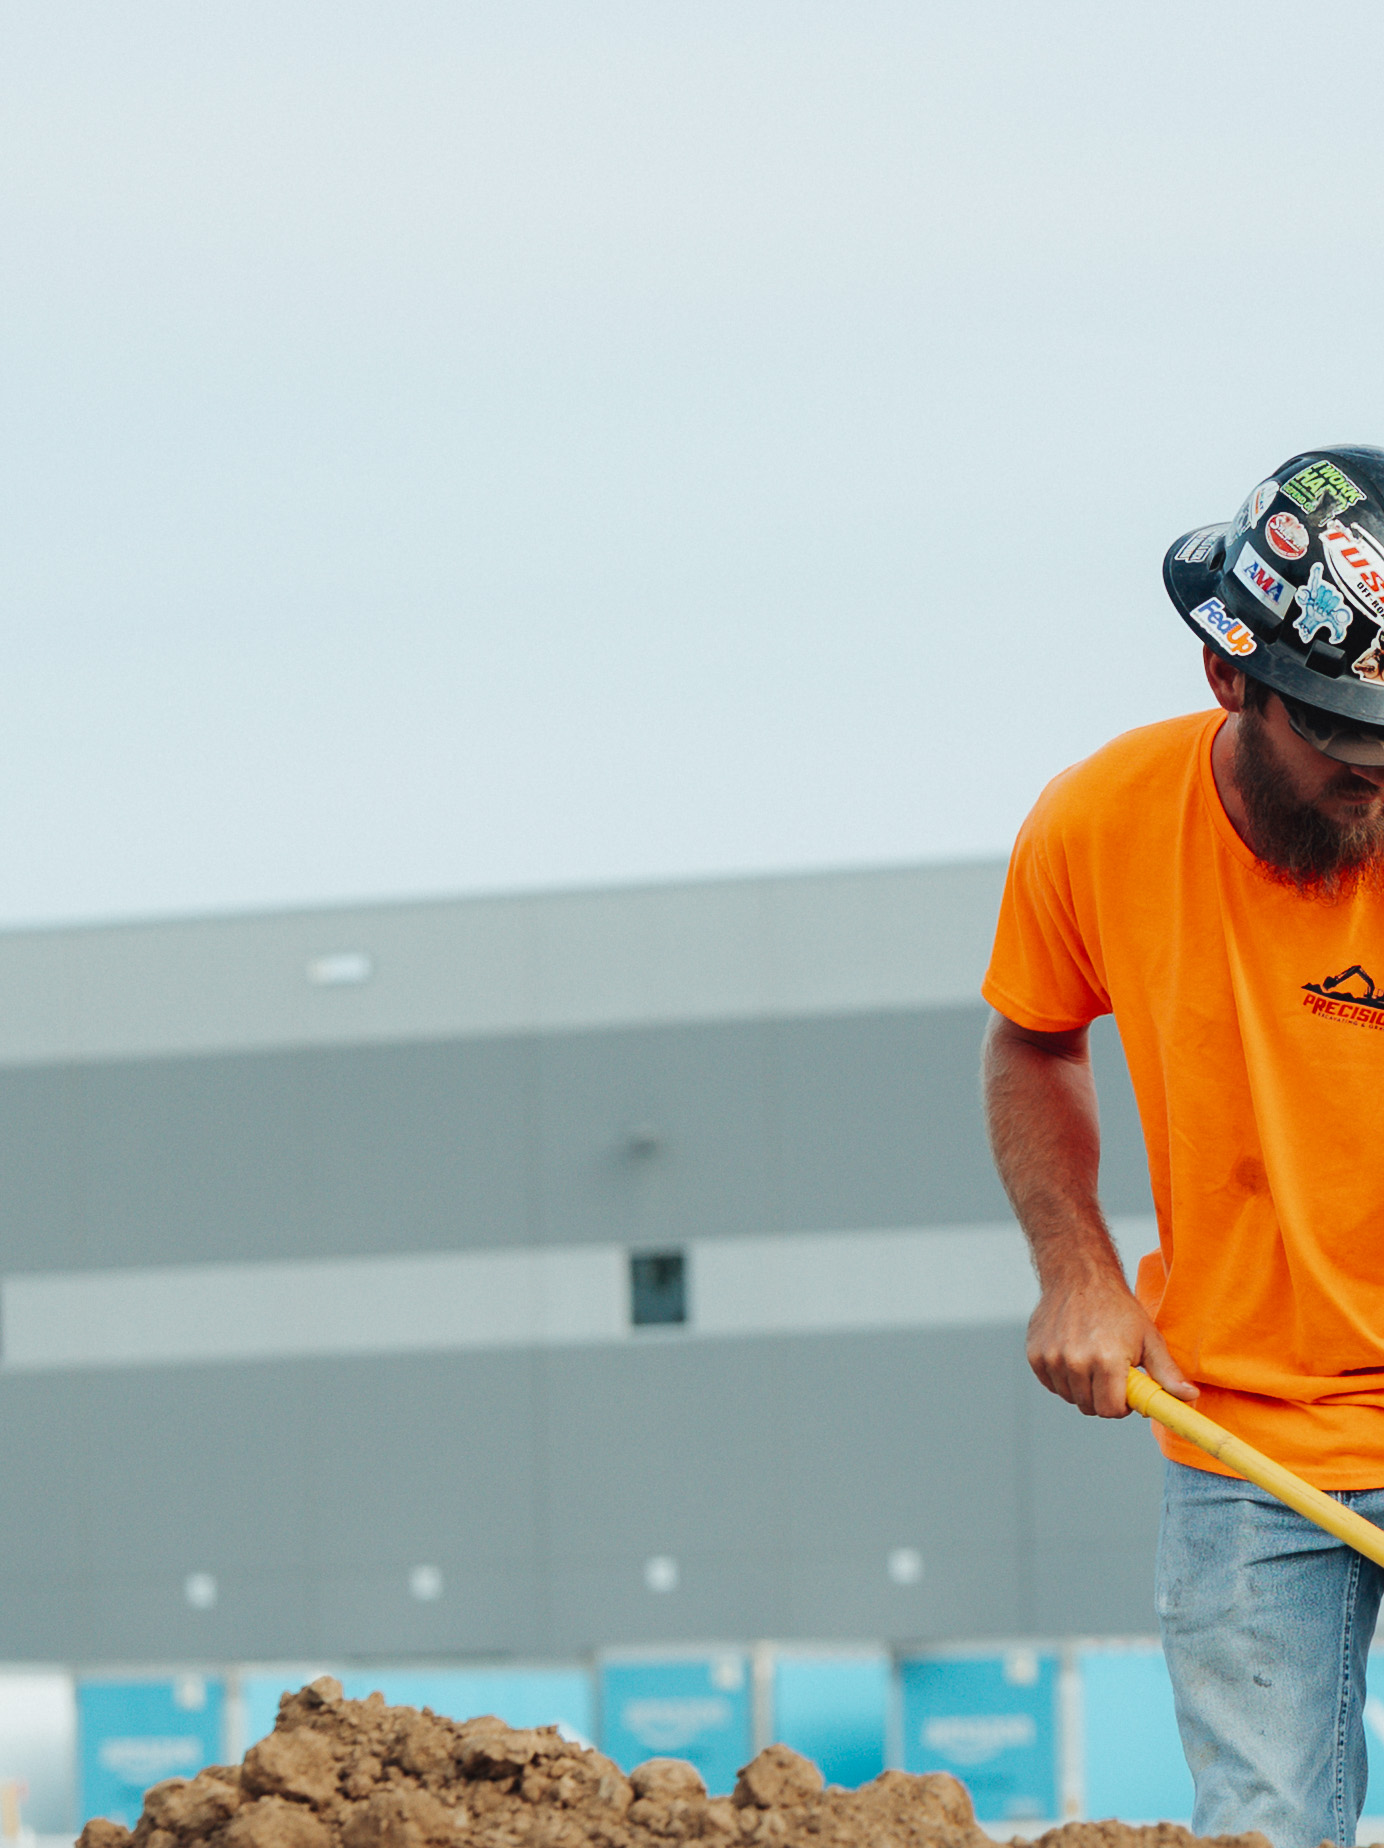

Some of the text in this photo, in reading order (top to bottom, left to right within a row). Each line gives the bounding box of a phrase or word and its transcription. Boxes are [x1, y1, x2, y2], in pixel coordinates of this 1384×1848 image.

[1312, 461, 1327, 469] I
[1319, 465, 1363, 503] WORK
[1244, 561, 1284, 602] AMA
[1198, 600, 1254, 653] FedUp
